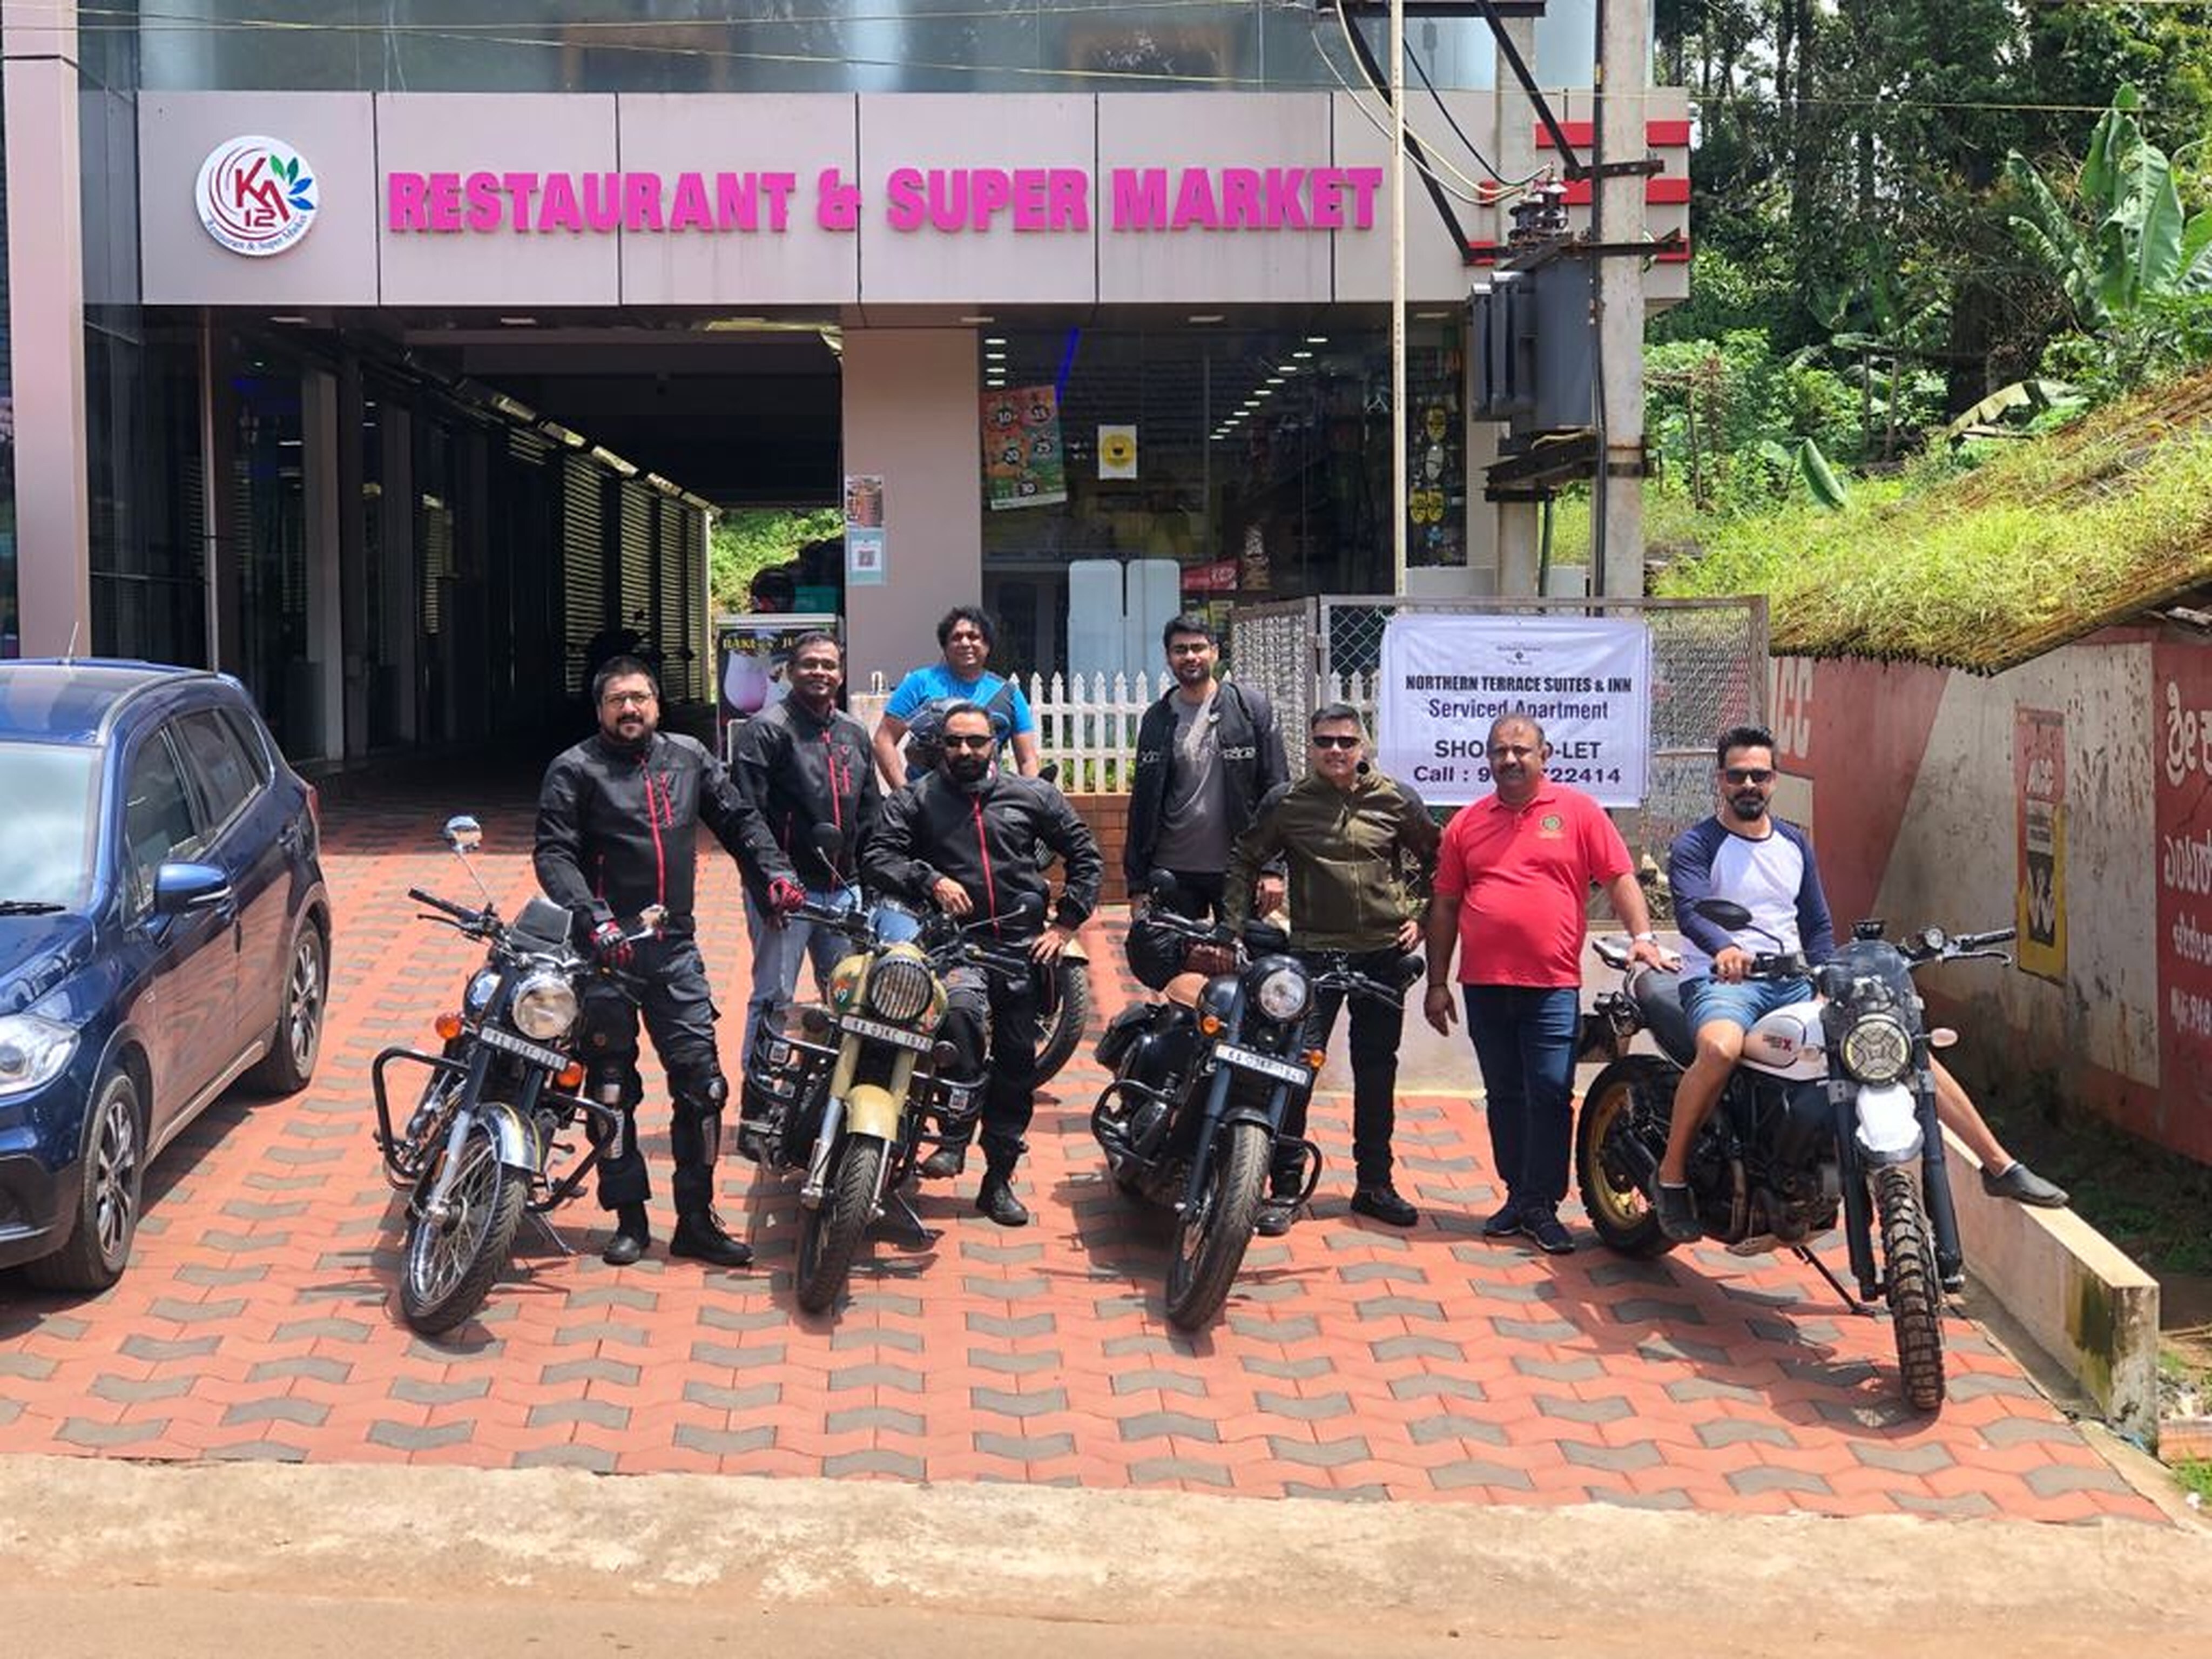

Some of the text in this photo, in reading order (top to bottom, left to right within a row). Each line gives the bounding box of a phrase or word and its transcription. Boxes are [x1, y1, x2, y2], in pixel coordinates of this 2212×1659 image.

[234, 157, 291, 222] KA
[388, 167, 1384, 233] RESTAURANT & SUPER MARKET
[245, 208, 276, 227] 12
[1406, 675, 1632, 693] NORTHERN TERRACE SUITES & INN
[1429, 698, 1608, 720] Serviced Apartment
[1435, 740, 1485, 758] SHO
[1414, 766, 1454, 782] Call
